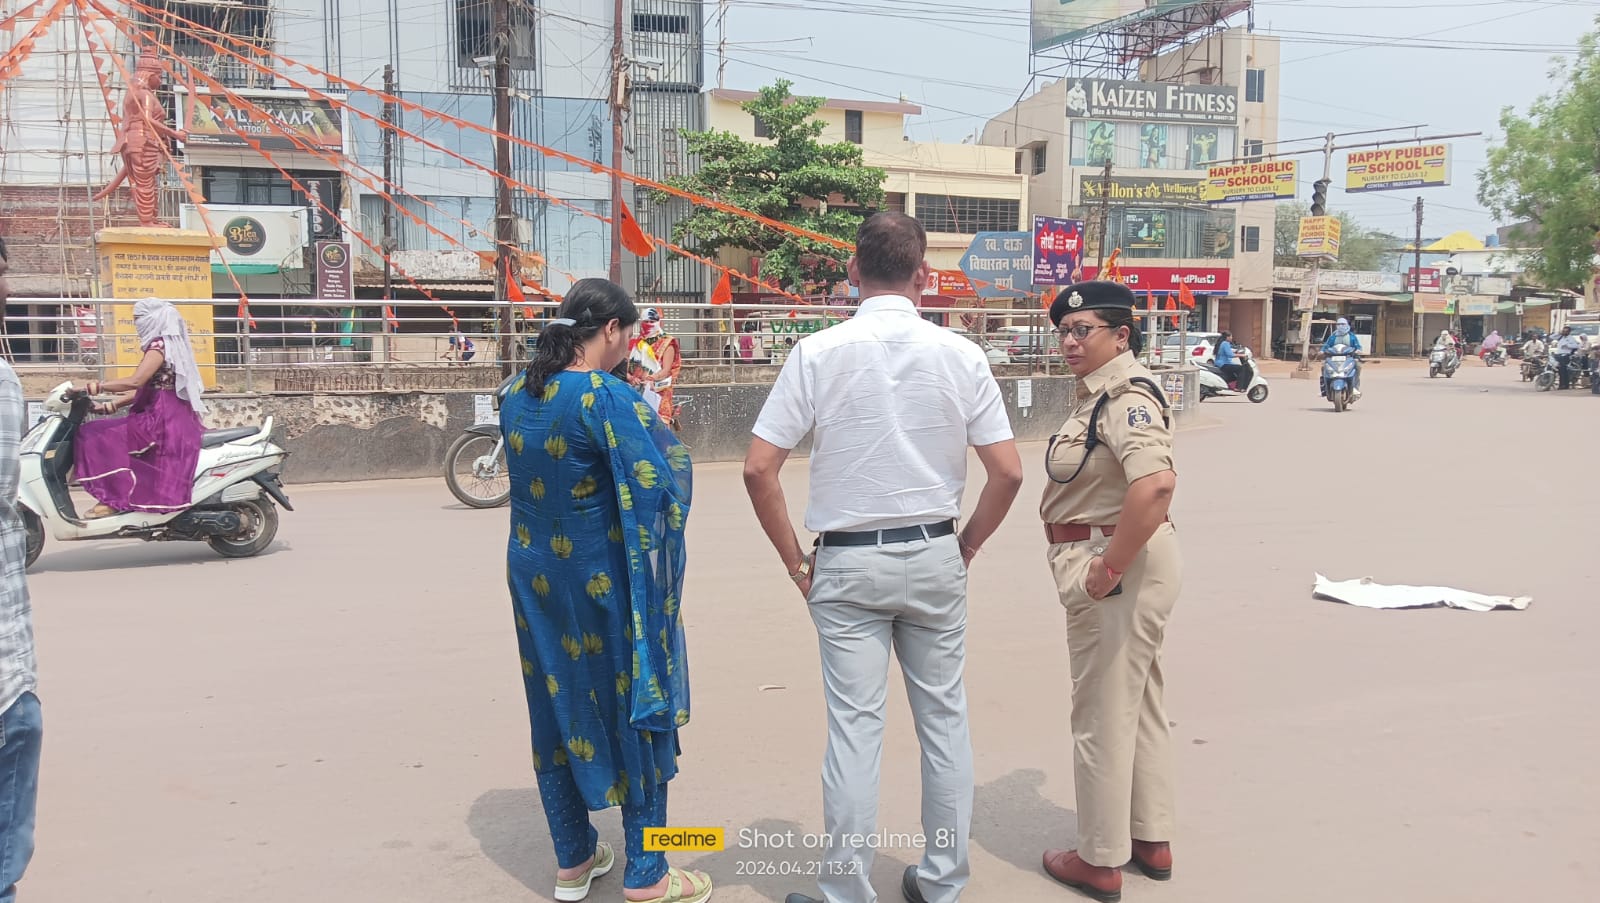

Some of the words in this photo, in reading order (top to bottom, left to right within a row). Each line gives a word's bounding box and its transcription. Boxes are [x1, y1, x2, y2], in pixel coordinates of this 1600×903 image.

[1347, 150, 1392, 164] HAPPY
[1395, 145, 1445, 159] PUBLIC
[1209, 165, 1248, 178] HAPPY
[1250, 161, 1294, 174] PUBLIC
[1368, 160, 1422, 173] SCHOOL
[1227, 175, 1274, 187] SCHOOL
[1003, 238, 1023, 252] दाऊ
